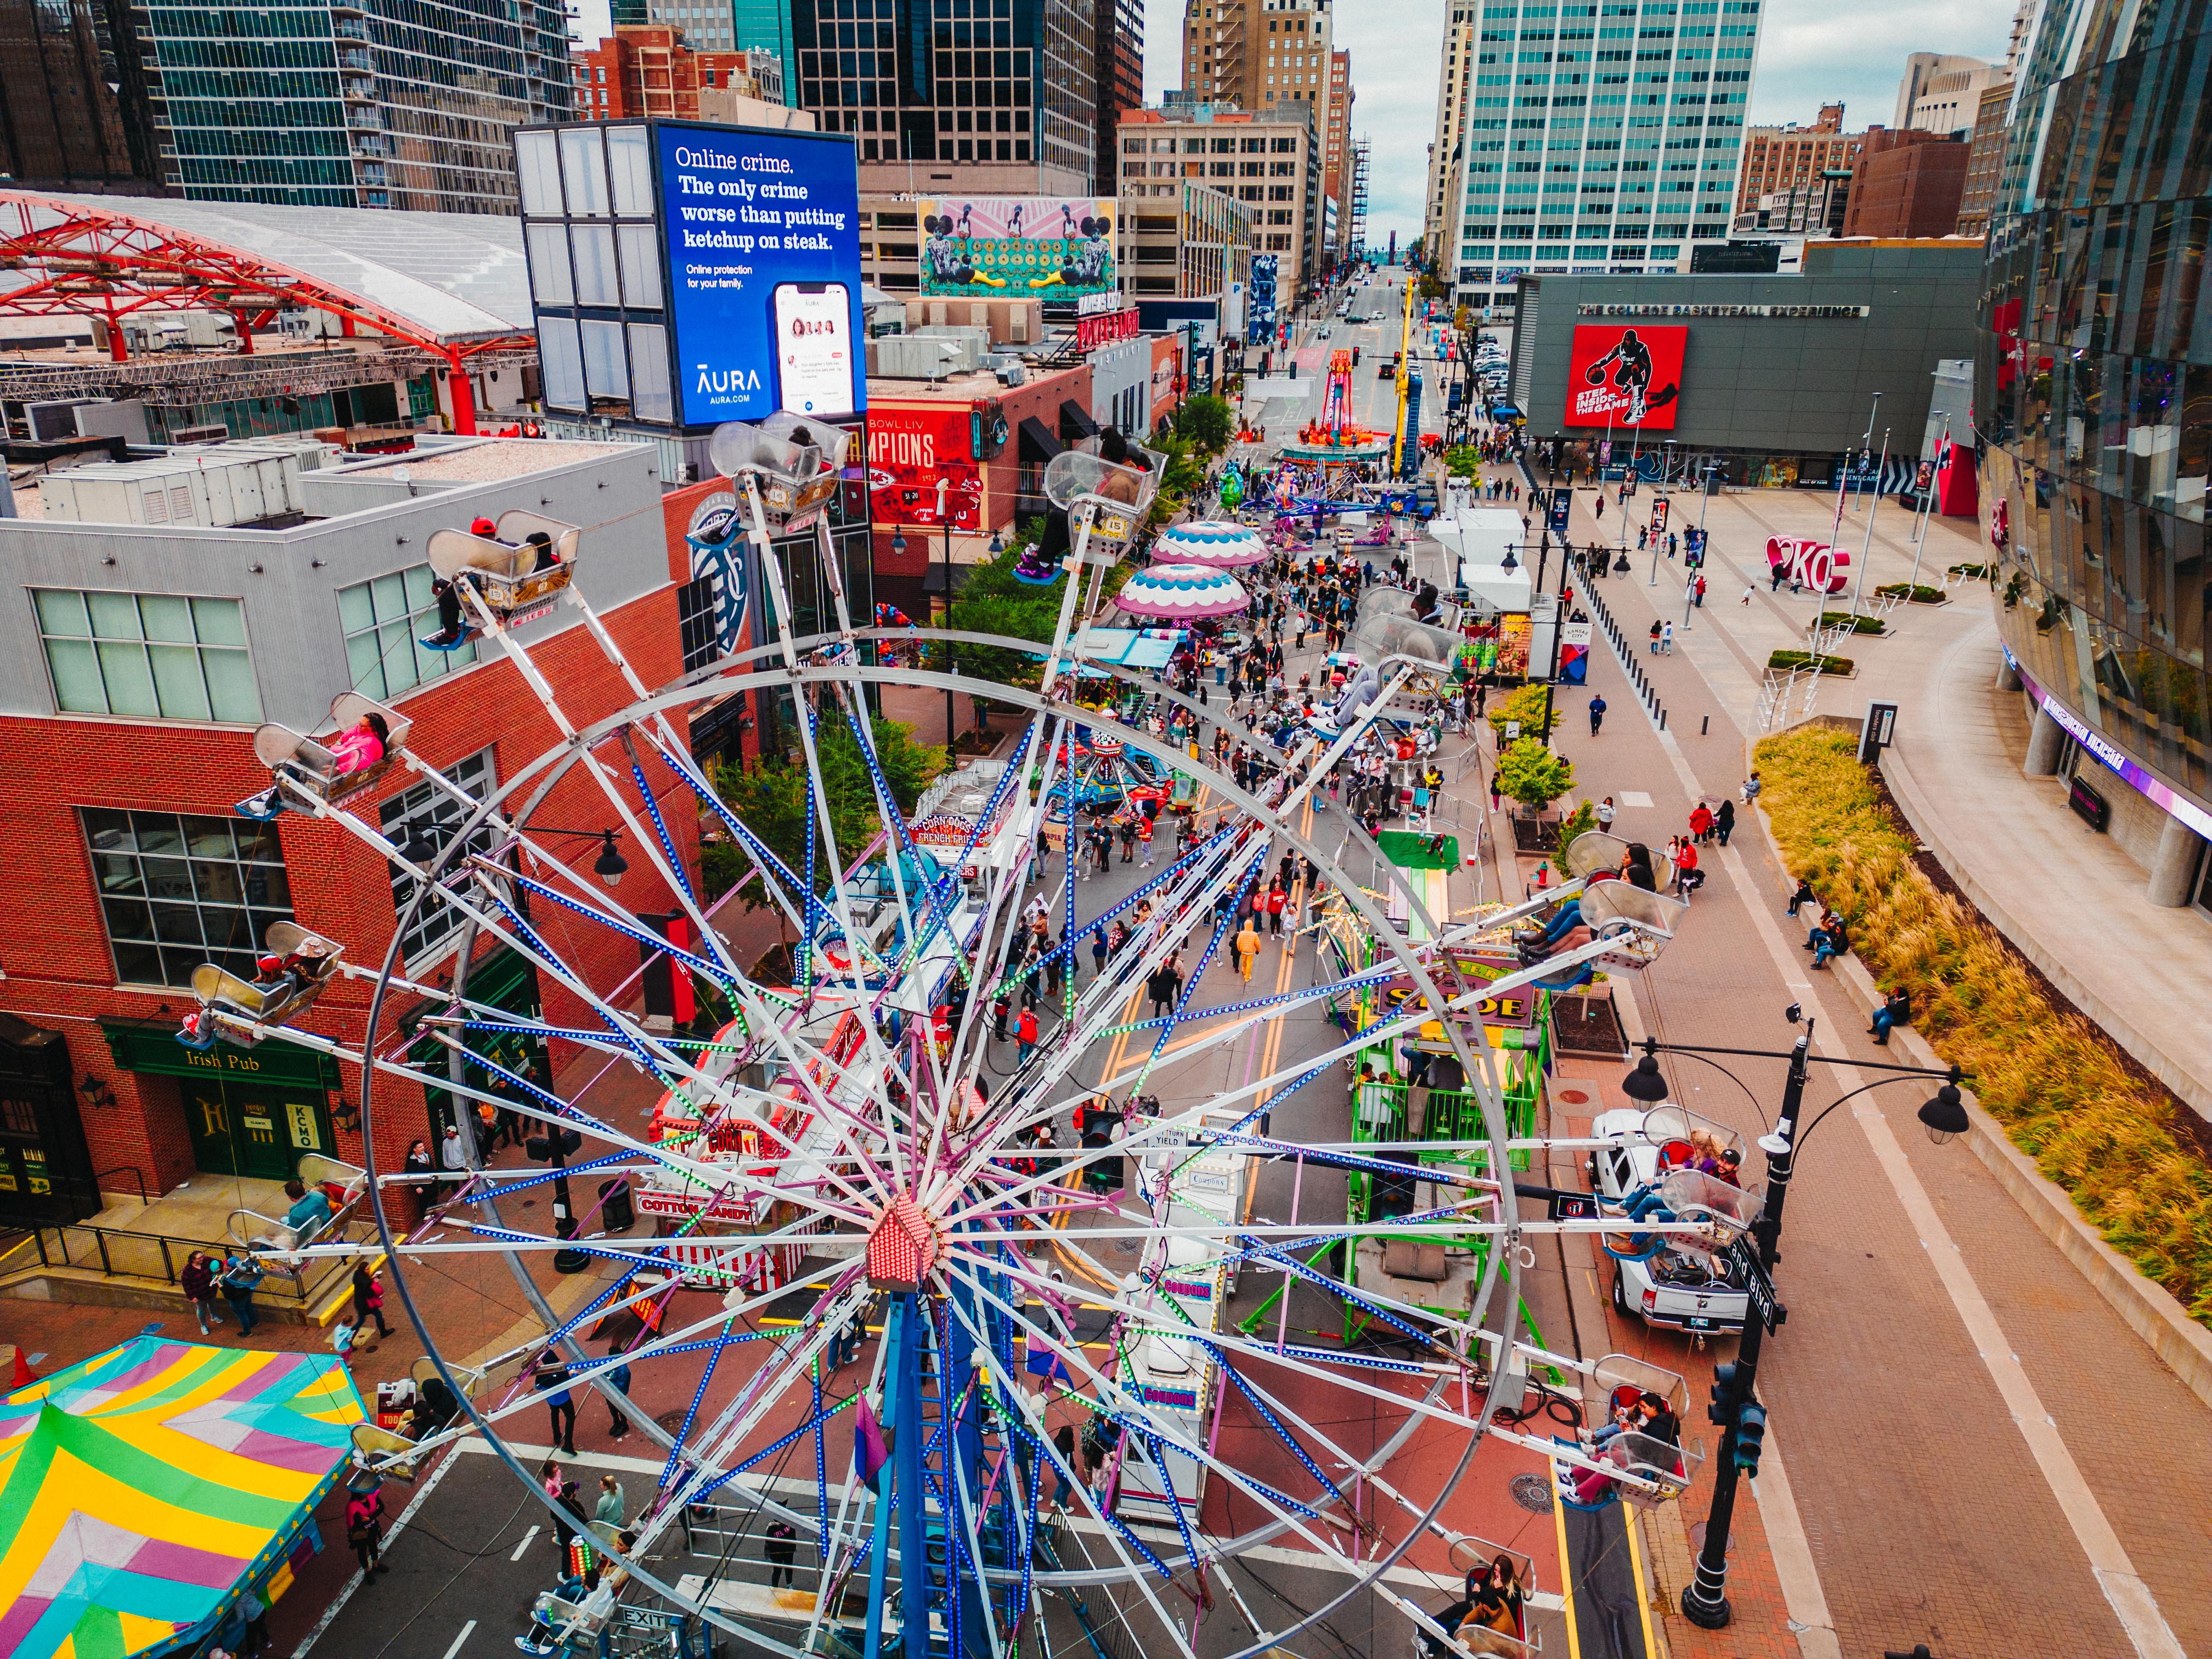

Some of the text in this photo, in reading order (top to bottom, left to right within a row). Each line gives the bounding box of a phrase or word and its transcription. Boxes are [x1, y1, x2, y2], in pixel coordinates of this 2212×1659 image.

[676, 146, 793, 174] Online crime.
[678, 175, 808, 201] The only crime
[681, 205, 845, 230] worse than putting
[683, 229, 833, 252] ketchup on steak.
[686, 264, 753, 276] Online protection
[687, 278, 743, 290] for your family.
[1233, 285, 1240, 294] P
[1577, 304, 1861, 318] THE COLLEGE BASKETBALL EXPERIENCE
[1079, 317, 1110, 349] POWER
[1118, 311, 1140, 337] LIGHT
[710, 394, 750, 404] AURA.COM
[1576, 393, 1616, 410] INSIDE
[1577, 387, 1607, 401] STEP
[1576, 398, 1629, 416] THE GAME
[869, 419, 924, 429] BOWL LIV
[691, 496, 721, 527] KANSAS
[1110, 521, 1120, 530] 15
[1791, 542, 1841, 593] KC
[1505, 614, 1527, 623] BEER
[1872, 710, 1882, 730] founders
[922, 816, 971, 833] CORN DOGS
[918, 833, 972, 844] FRENCH FRI
[963, 927, 978, 952] FUNNEL
[814, 969, 844, 978] FRD
[1459, 962, 1498, 980] PER
[930, 981, 941, 1003] HOT
[1386, 988, 1528, 1020] SDE
[186, 1051, 259, 1070] Irish Pub
[196, 1097, 228, 1137] H
[295, 1107, 312, 1147] KCMO
[1156, 1137, 1178, 1146] YIELD
[1194, 1175, 1224, 1186] Coupons
[641, 1199, 699, 1215] COTTON
[1165, 1279, 1210, 1299] Coupons
[1750, 1275, 1770, 1318] Blvd
[1144, 1387, 1195, 1407] Coupons
[384, 1415, 399, 1425] TOD
[624, 1609, 664, 1627] EXIT
